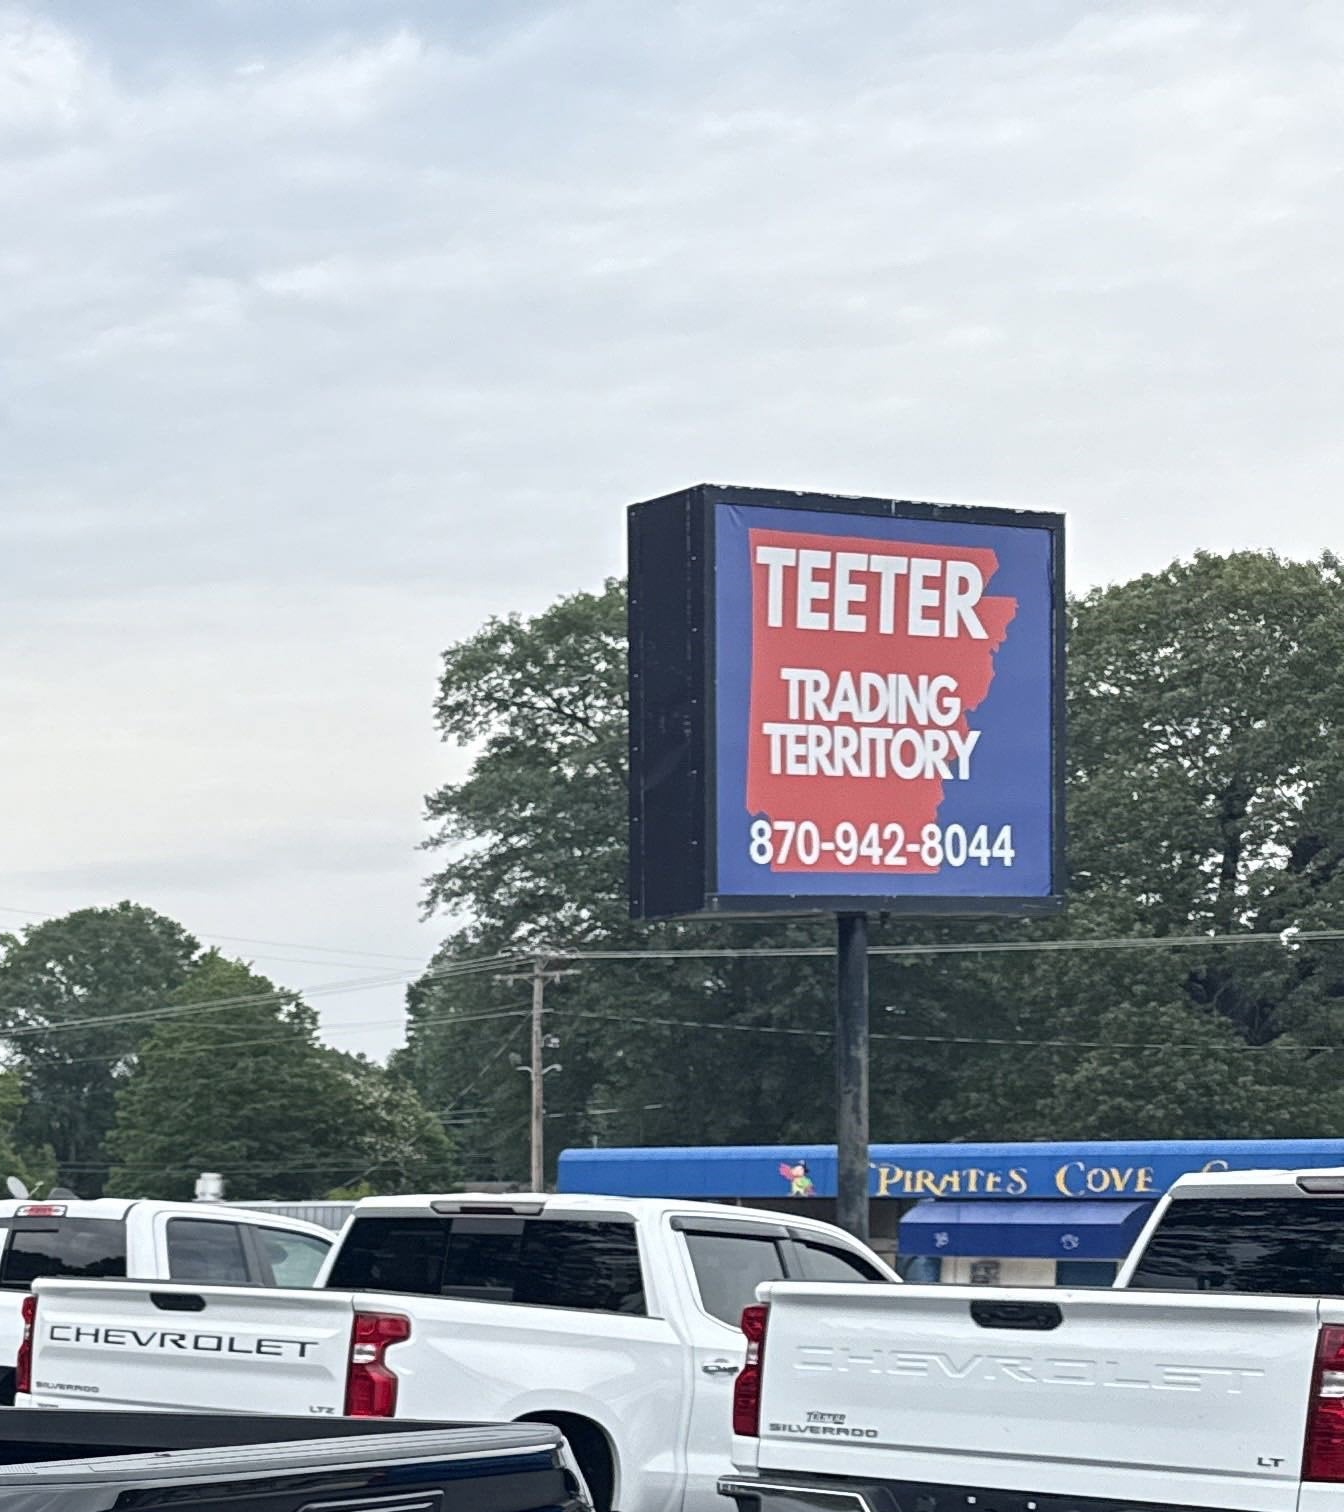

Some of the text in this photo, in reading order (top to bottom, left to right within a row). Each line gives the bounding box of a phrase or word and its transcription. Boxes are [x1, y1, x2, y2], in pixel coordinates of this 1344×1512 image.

[756, 546, 989, 640] TEETER
[780, 667, 961, 727] TRADING
[761, 722, 981, 780] TERRITORY
[749, 819, 1015, 867] 870-942-8044
[871, 1161, 1164, 1197] PIRATES COVE
[49, 1325, 319, 1358] CHEVROLET
[35, 1381, 100, 1393] SILVERADO
[793, 1345, 1265, 1395] CHEVROLET
[768, 1422, 879, 1438] SILVERADO
[1256, 1457, 1285, 1468] LT
